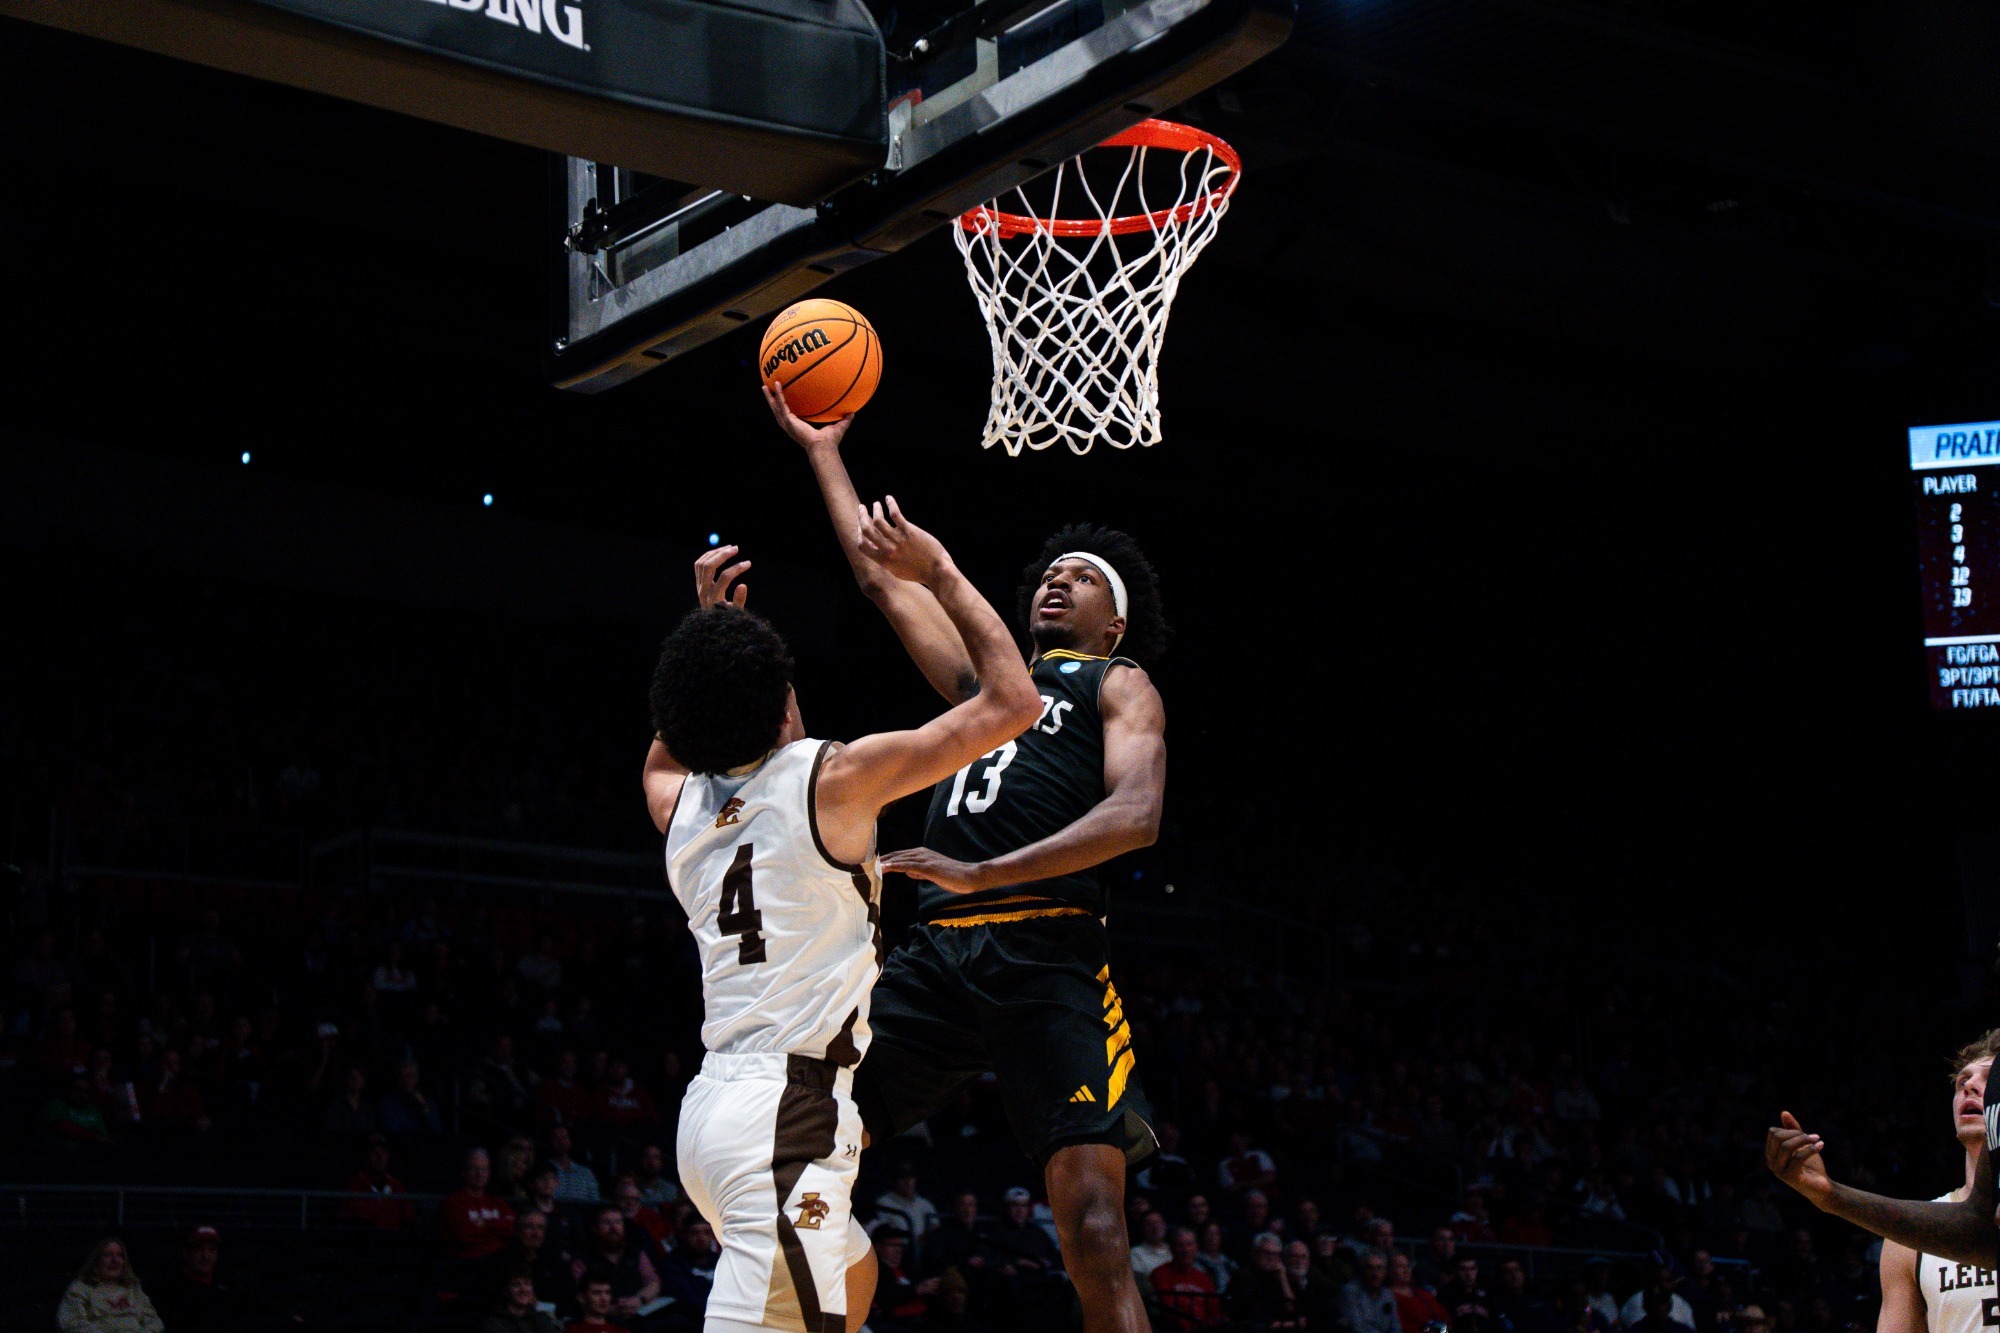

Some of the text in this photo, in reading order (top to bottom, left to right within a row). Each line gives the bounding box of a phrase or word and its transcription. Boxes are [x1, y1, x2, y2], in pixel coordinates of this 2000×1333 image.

[763, 328, 831, 379] Wilson
[1935, 429, 2000, 459] PRAI
[1922, 474, 1977, 495] PLAYER
[1949, 502, 1962, 523] 2
[1950, 523, 1964, 544] 3
[1952, 544, 1965, 565] 4
[1950, 565, 1970, 586] 12
[1952, 587, 1972, 607] 13
[1946, 644, 2000, 665] FG/FGA
[1952, 687, 2000, 708] FT/FTA
[946, 739, 1018, 818] 13
[716, 842, 767, 966] 4
